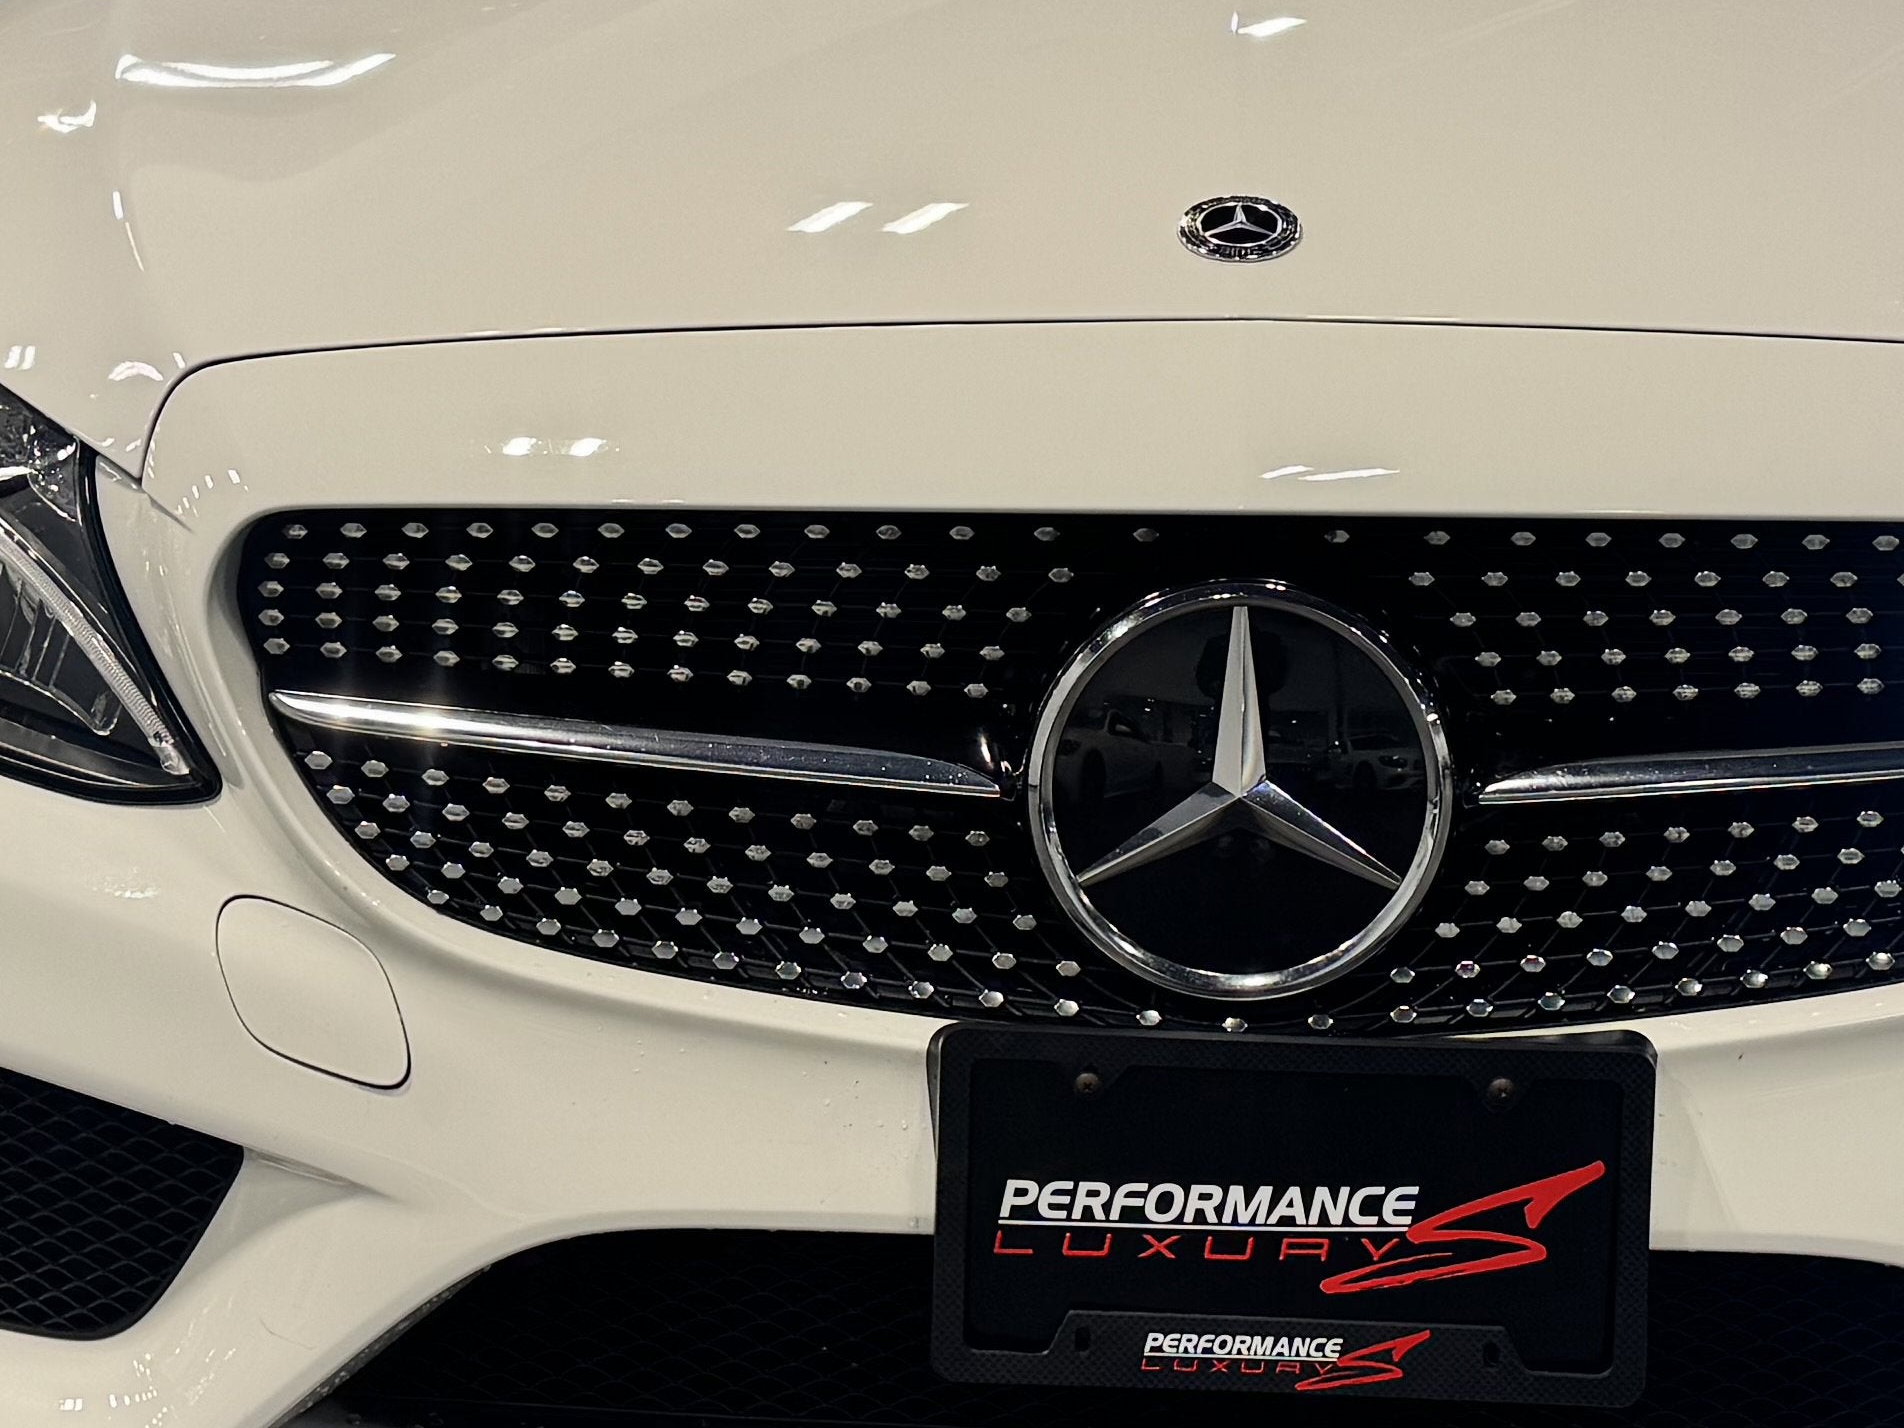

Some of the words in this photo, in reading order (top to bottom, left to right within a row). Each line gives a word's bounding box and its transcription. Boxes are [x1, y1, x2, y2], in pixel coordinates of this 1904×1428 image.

[999, 1178, 1420, 1225] PERFORMANCE
[993, 1229, 1400, 1262] LUXURY
[1144, 1332, 1344, 1358] PERFORMANCE
[1141, 1358, 1334, 1374] LUXURY
